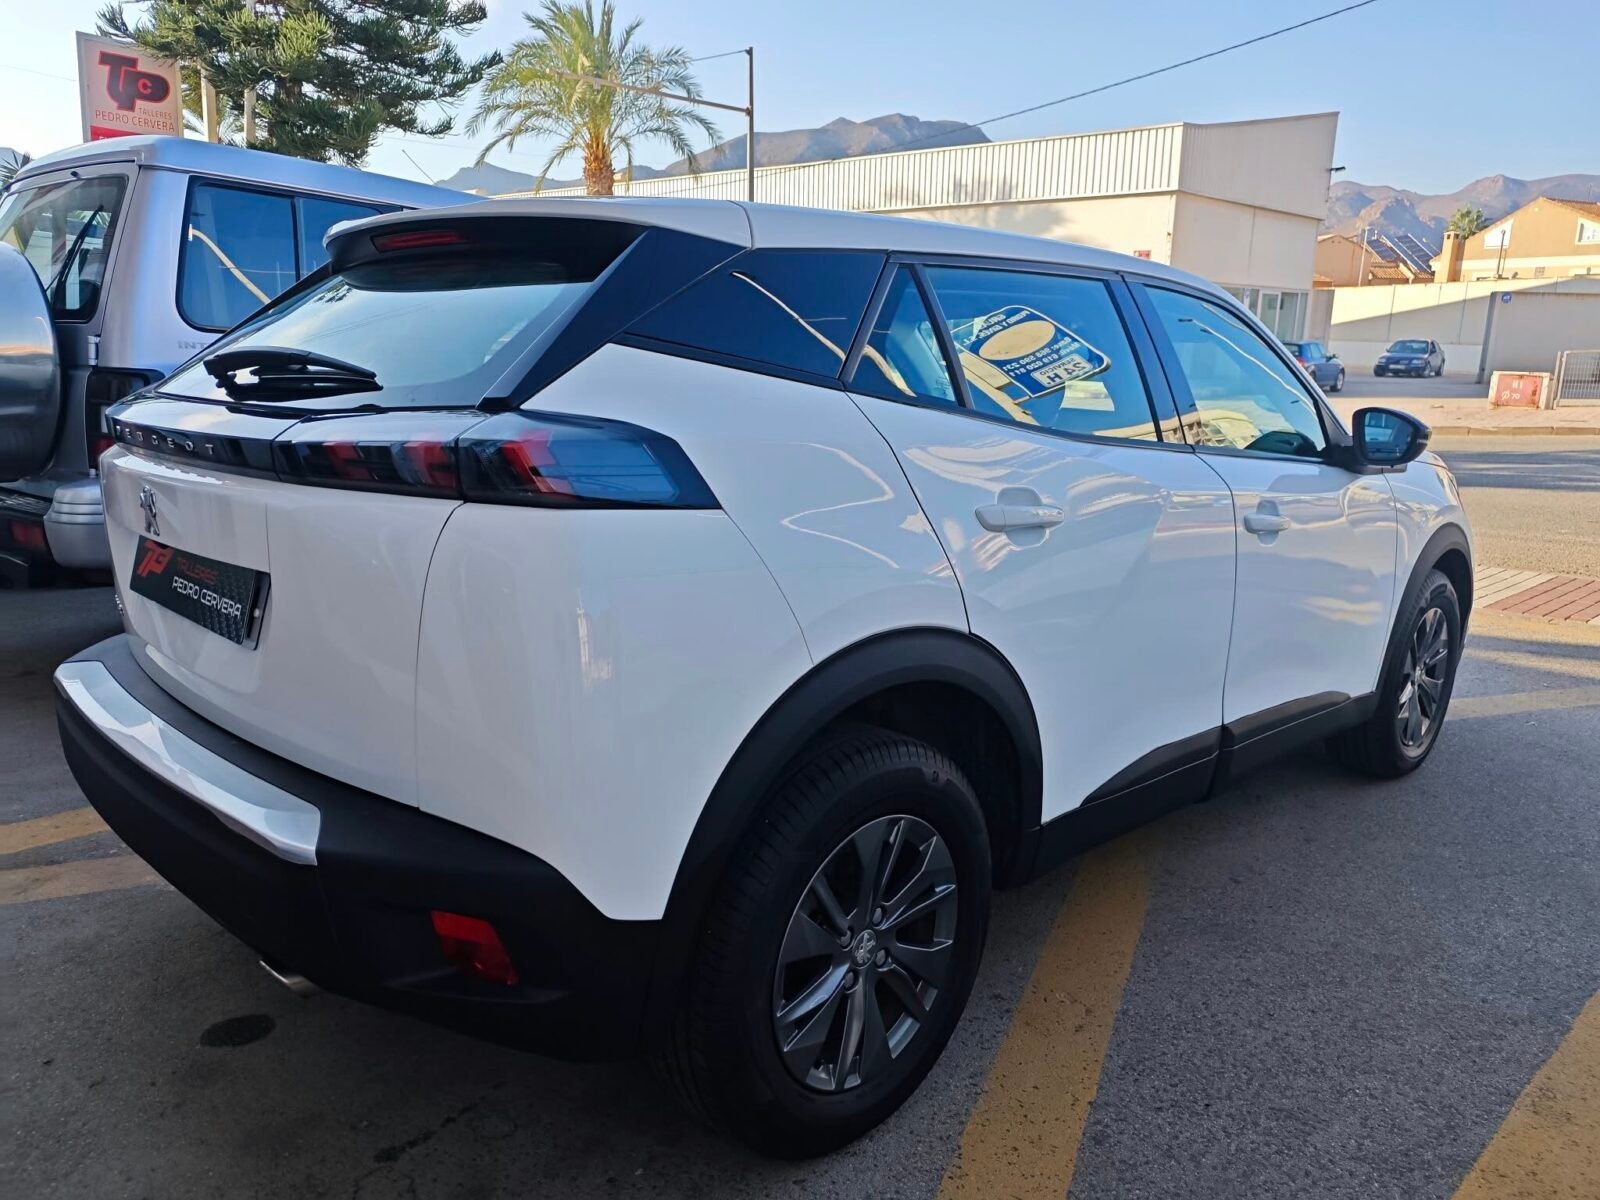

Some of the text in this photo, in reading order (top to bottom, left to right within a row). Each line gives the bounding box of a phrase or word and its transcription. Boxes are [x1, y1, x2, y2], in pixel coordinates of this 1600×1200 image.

[95, 110, 175, 132] PEDRO CERVERA
[138, 107, 173, 120] TALLERES
[177, 340, 209, 349] INT
[171, 576, 242, 619] PEDRO CERVERA
